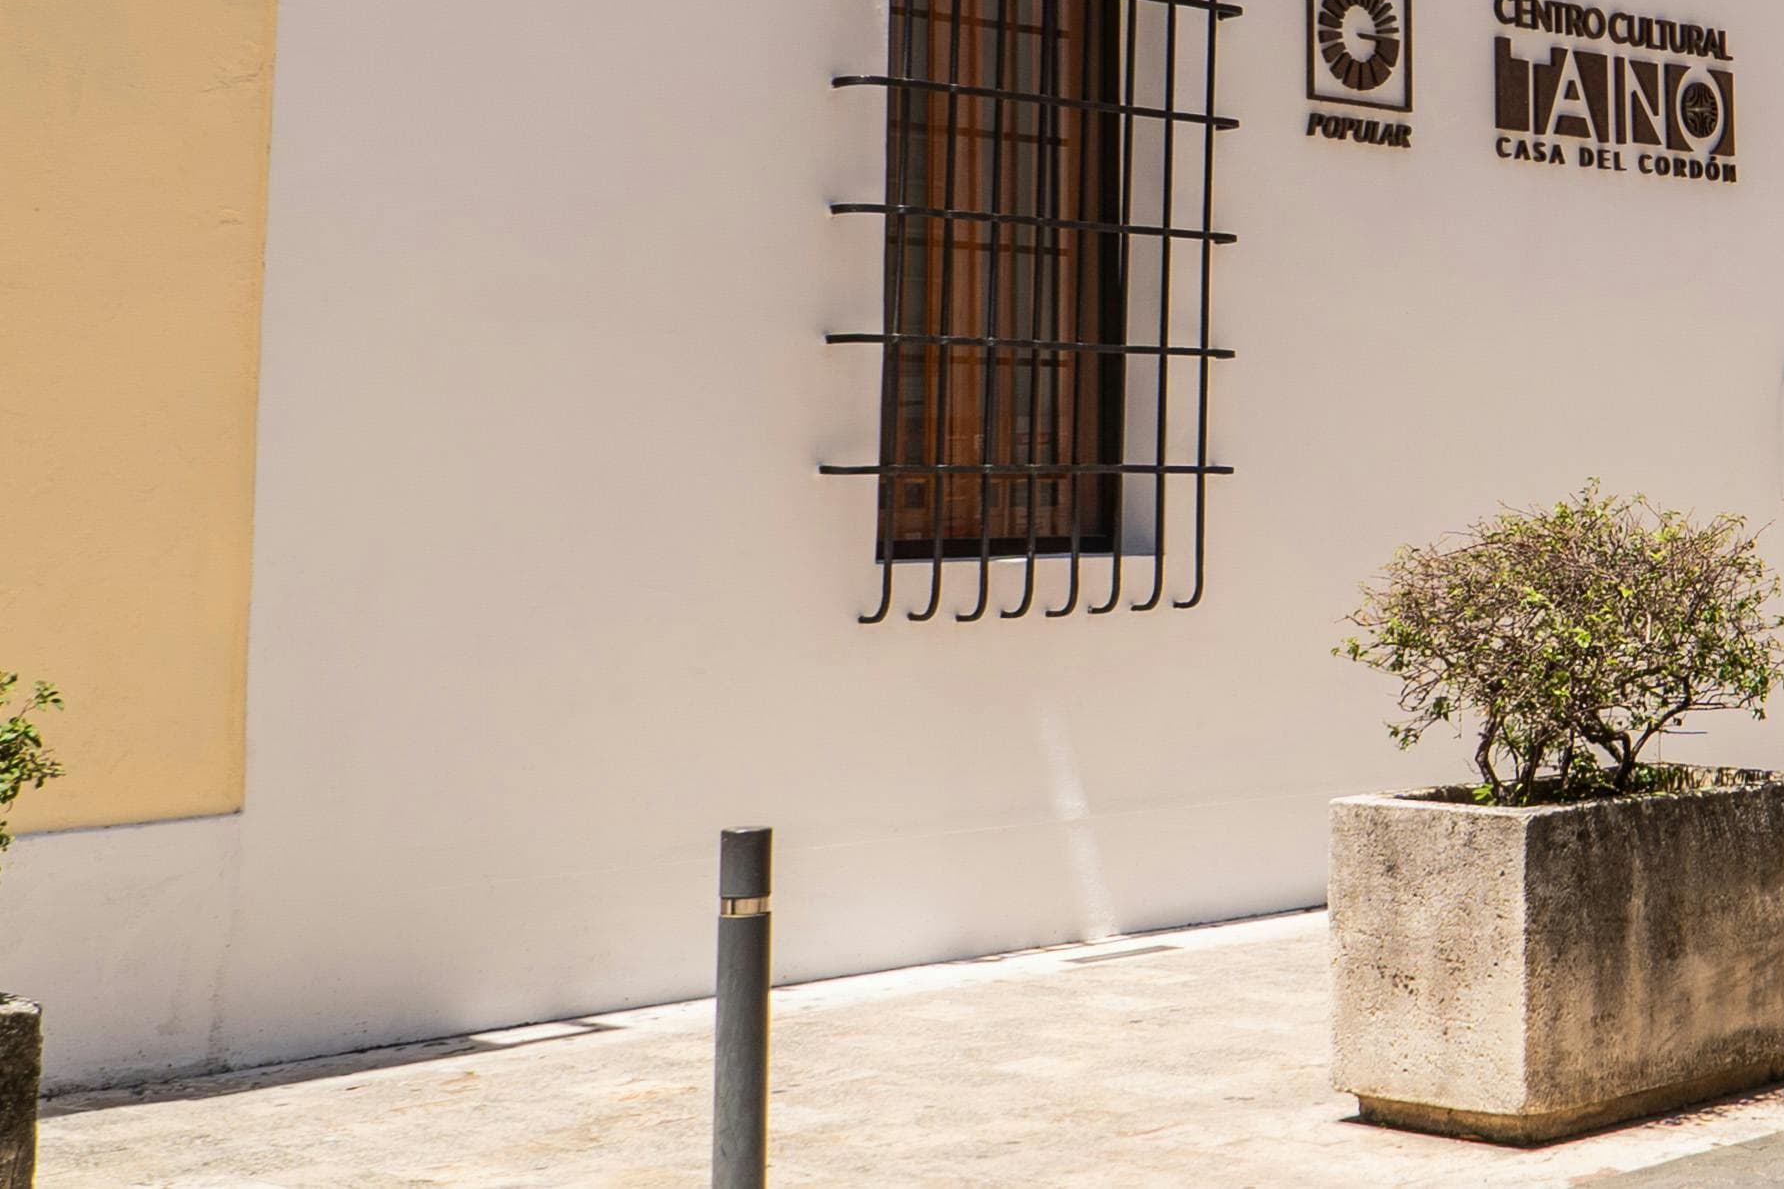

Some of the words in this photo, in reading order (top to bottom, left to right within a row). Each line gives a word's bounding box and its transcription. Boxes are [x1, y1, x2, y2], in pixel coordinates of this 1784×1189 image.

[1608, 12, 1733, 61] CULTURAL
[1306, 112, 1412, 148] POPULAR
[1496, 137, 1566, 165] CASA
[1579, 147, 1627, 171] DEL
[1638, 155, 1736, 183] CORDÓN
